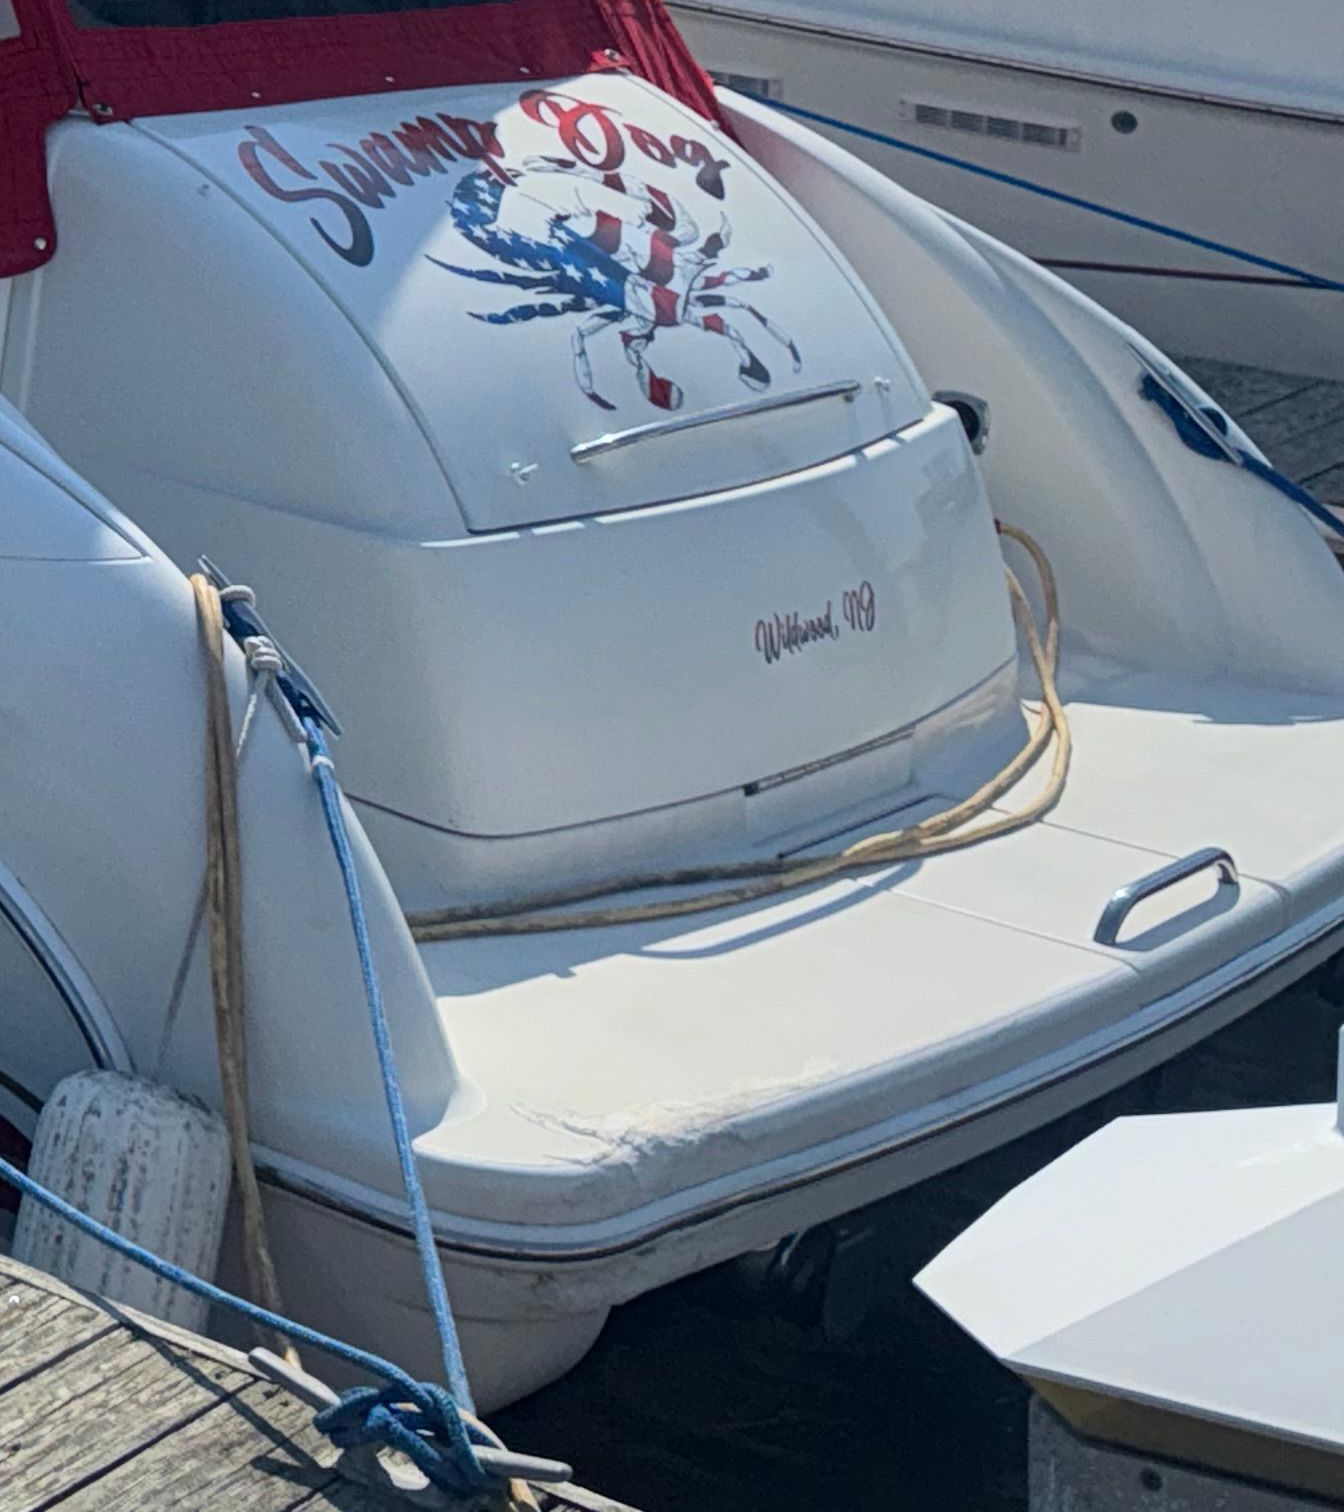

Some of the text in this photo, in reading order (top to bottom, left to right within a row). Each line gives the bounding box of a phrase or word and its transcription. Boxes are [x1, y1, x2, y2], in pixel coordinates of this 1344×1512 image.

[237, 89, 730, 267] Swamp Dog
[842, 580, 876, 632] NJ
